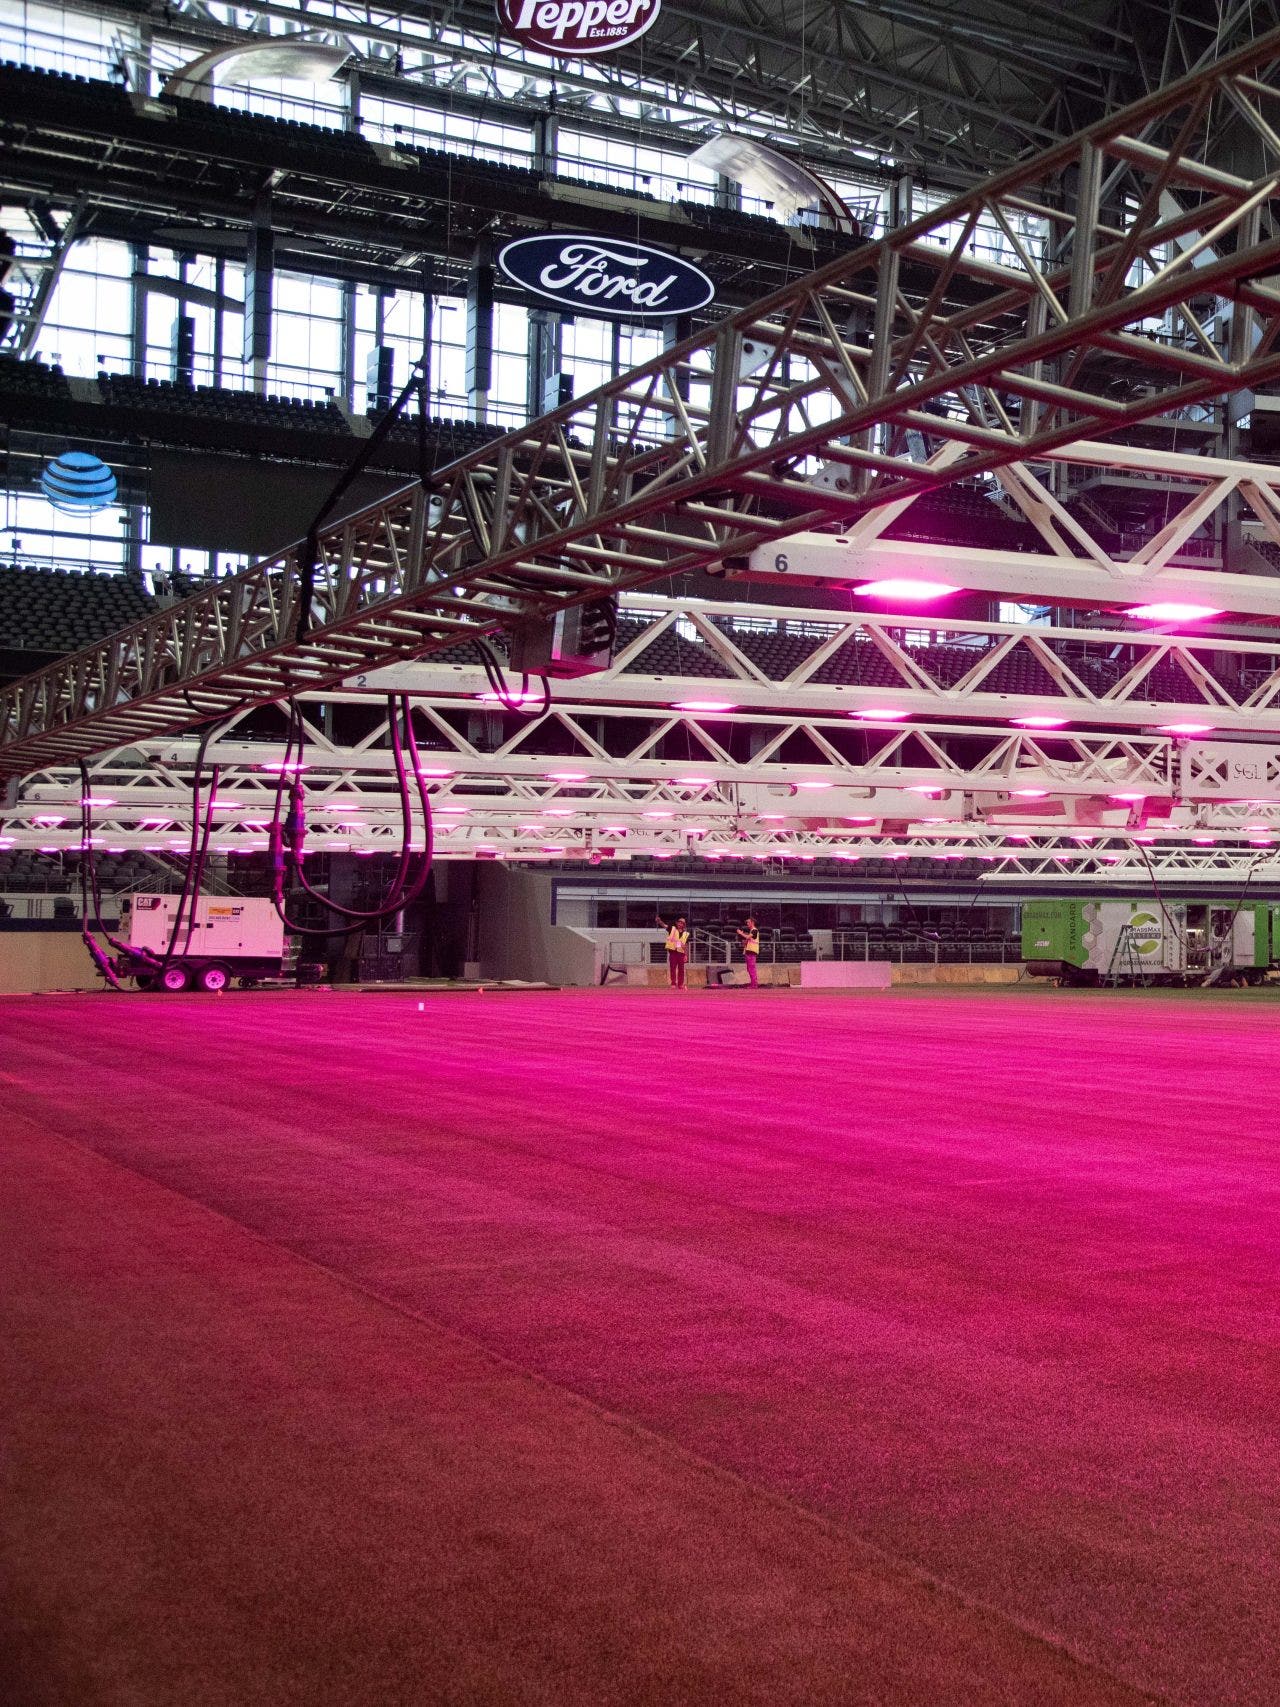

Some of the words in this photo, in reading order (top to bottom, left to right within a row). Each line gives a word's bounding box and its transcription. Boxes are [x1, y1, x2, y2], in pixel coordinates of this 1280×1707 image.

[540, 244, 678, 307] Ford
[775, 553, 788, 573] 6
[357, 675, 367, 687] 2
[171, 753, 178, 761] 4
[138, 898, 154, 907] CAT
